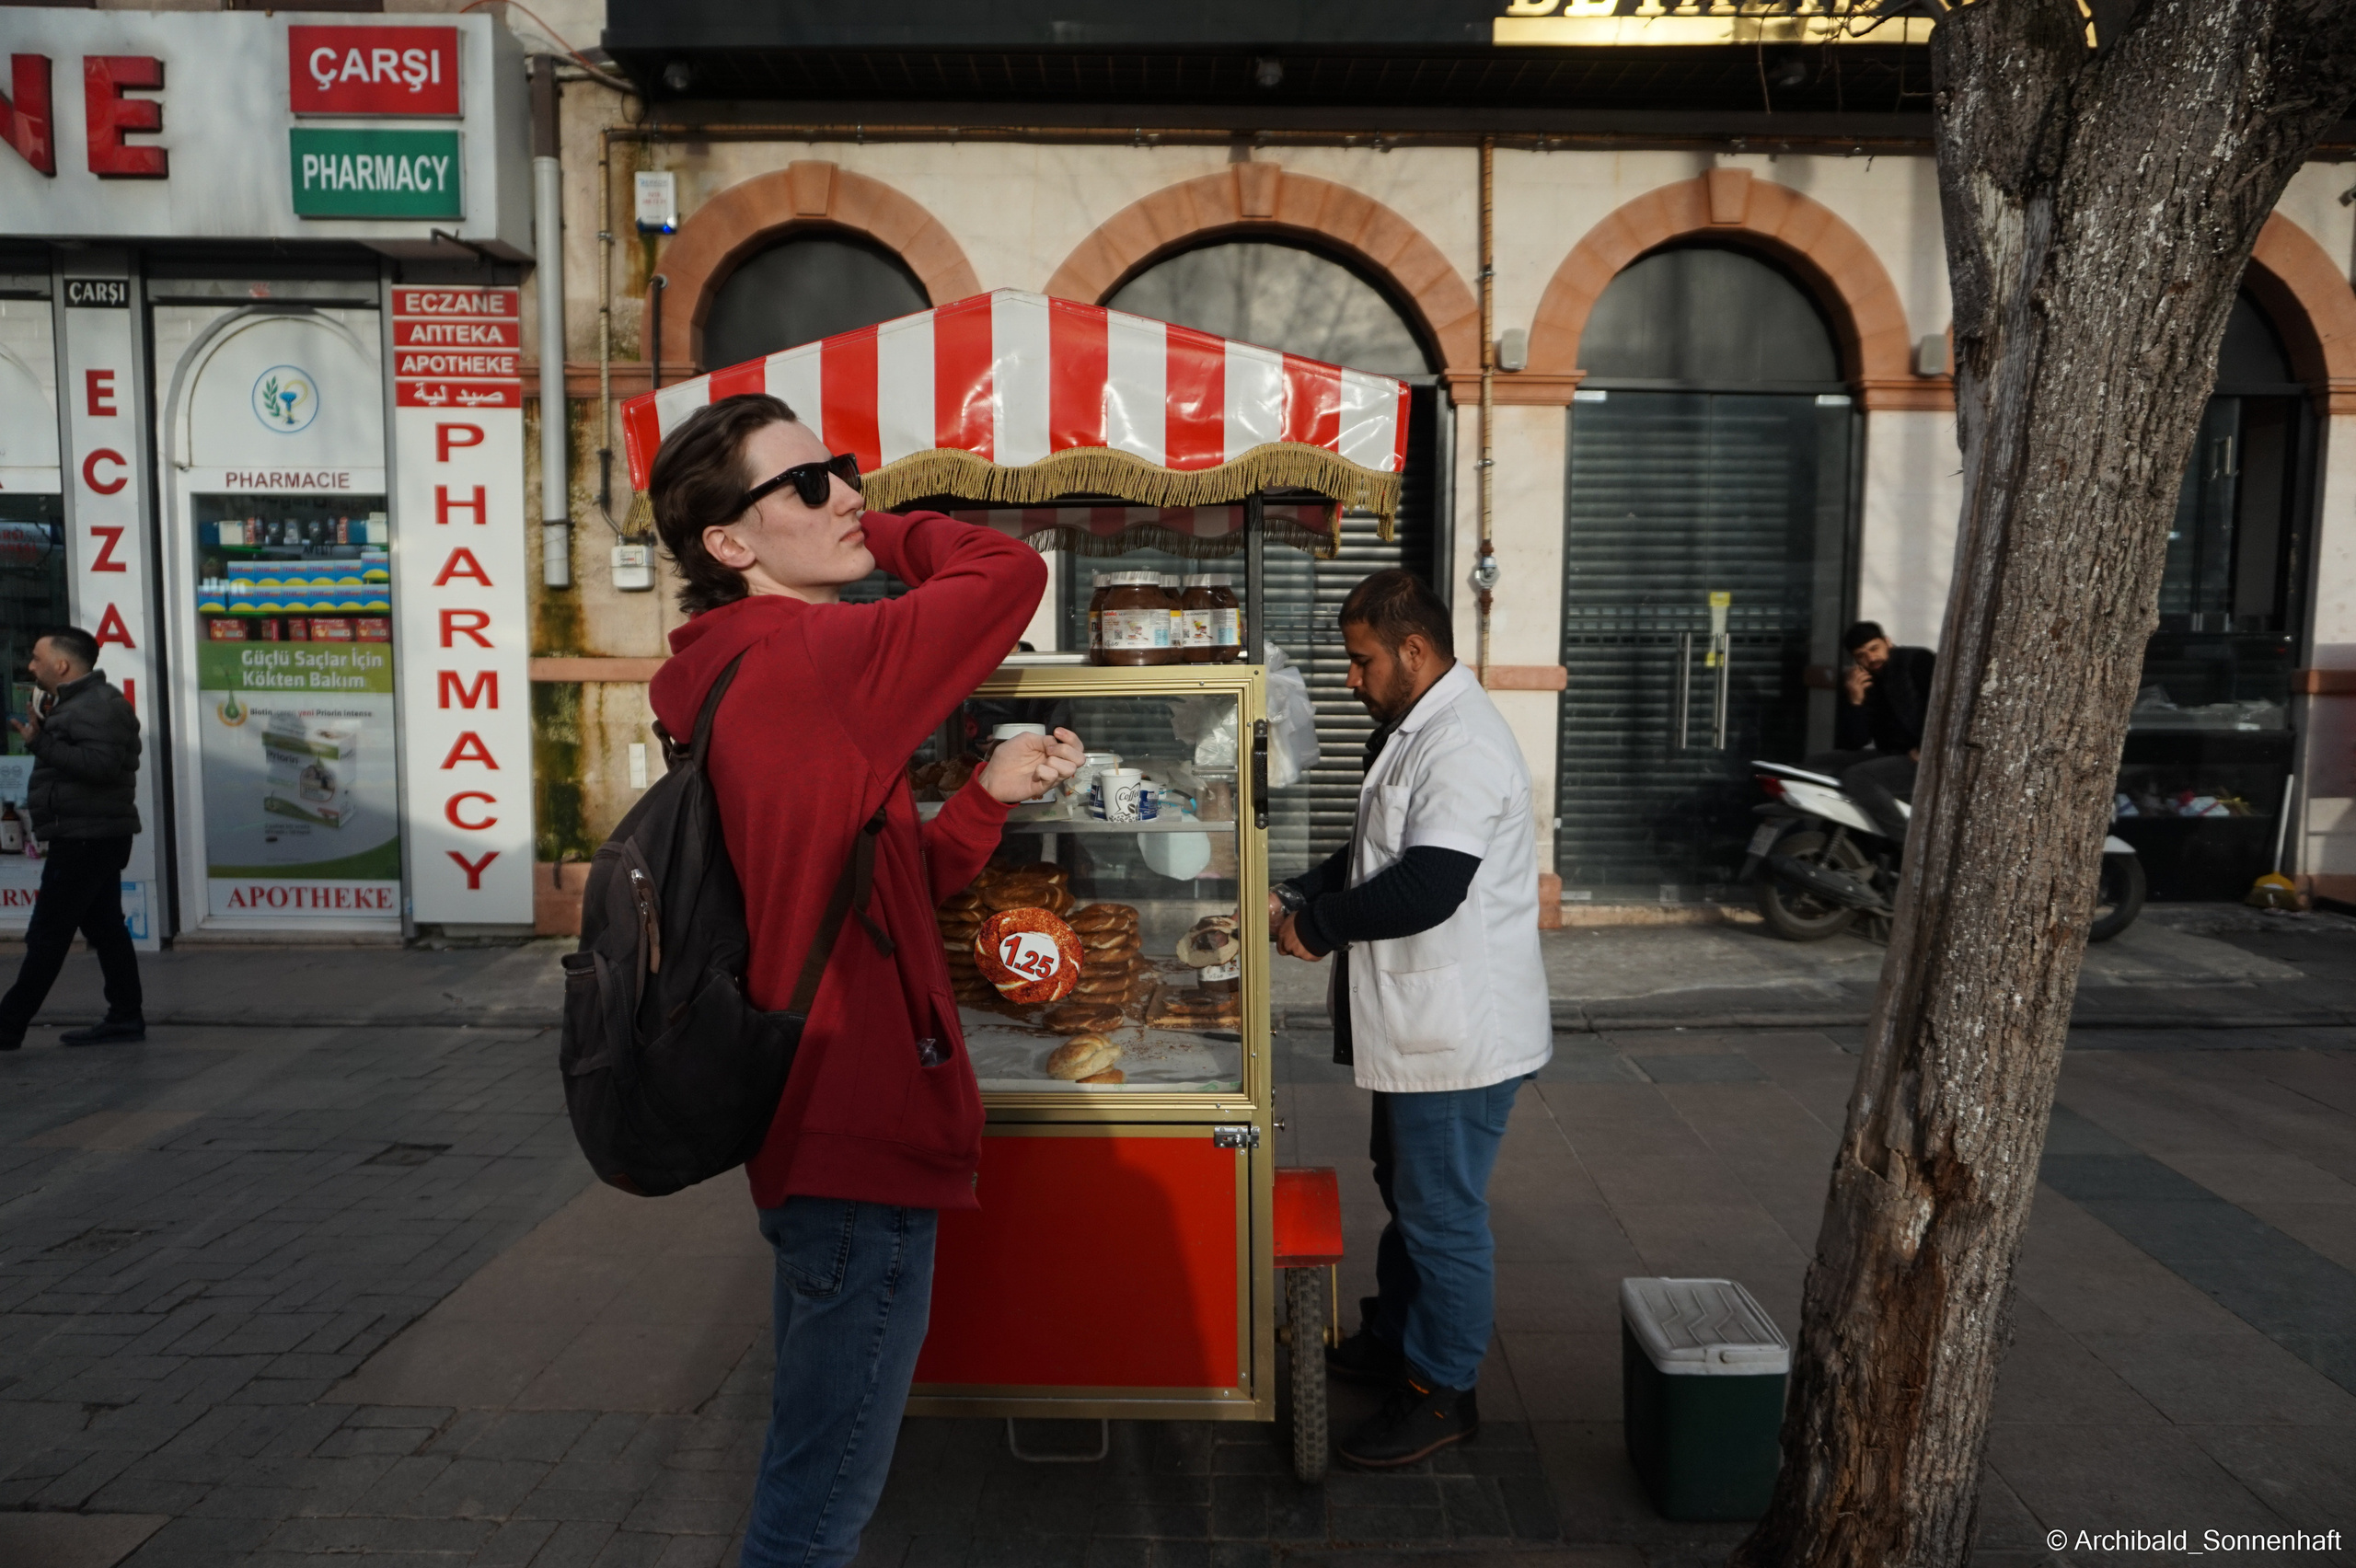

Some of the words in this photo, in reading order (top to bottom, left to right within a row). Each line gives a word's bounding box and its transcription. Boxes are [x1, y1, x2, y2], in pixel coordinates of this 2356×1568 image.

[309, 47, 441, 92] ÇARŞI
[302, 154, 451, 192] PHARMACY
[69, 282, 126, 306] ÇARŞI
[405, 293, 504, 314] ECZANE
[409, 323, 504, 345] АПТЕКА
[400, 354, 514, 375] APOTHEKE
[225, 471, 351, 490] PHARMACIE
[241, 649, 290, 670] Güçlü
[294, 650, 348, 671] Saçlar
[352, 647, 383, 671] İçin
[433, 421, 501, 891] PHARMACY
[242, 671, 305, 687] Kökten
[309, 672, 365, 688] Bakım
[249, 708, 273, 717] Biotin
[226, 885, 394, 911] APOTHEKE
[1004, 935, 1055, 979] 1.25
